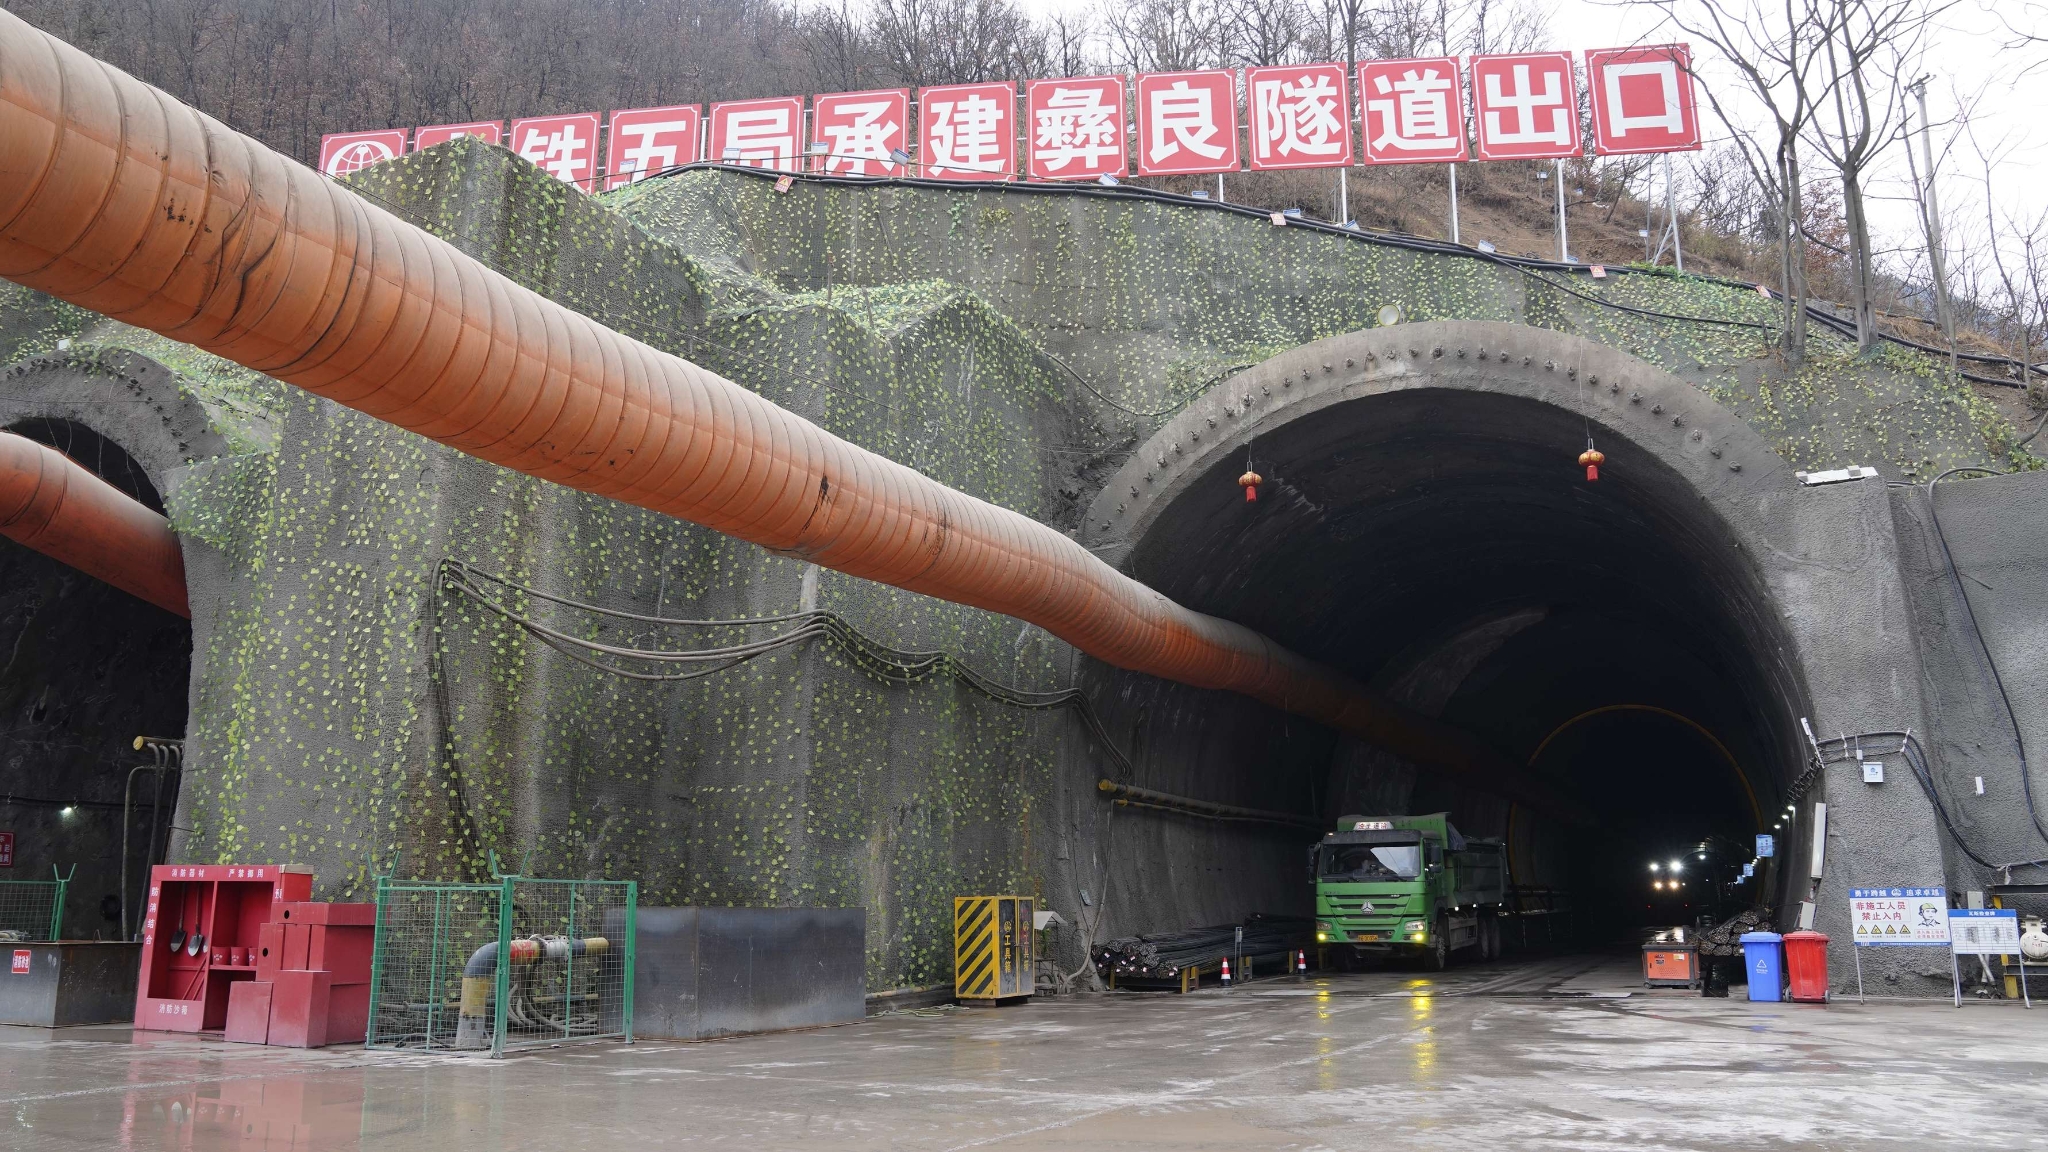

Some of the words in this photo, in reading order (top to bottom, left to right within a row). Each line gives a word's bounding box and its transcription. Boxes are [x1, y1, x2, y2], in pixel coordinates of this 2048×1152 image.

[450, 60, 1684, 192] 铁五局承建彝良隧道出口
[171, 868, 205, 878] 消防器材
[228, 868, 264, 878] 严禁挪用
[1854, 889, 1887, 898] 勇于跨越
[1906, 888, 1940, 897] 追求卓越
[1856, 901, 1906, 911] 非施工人员
[1861, 911, 1902, 921] 禁止入内
